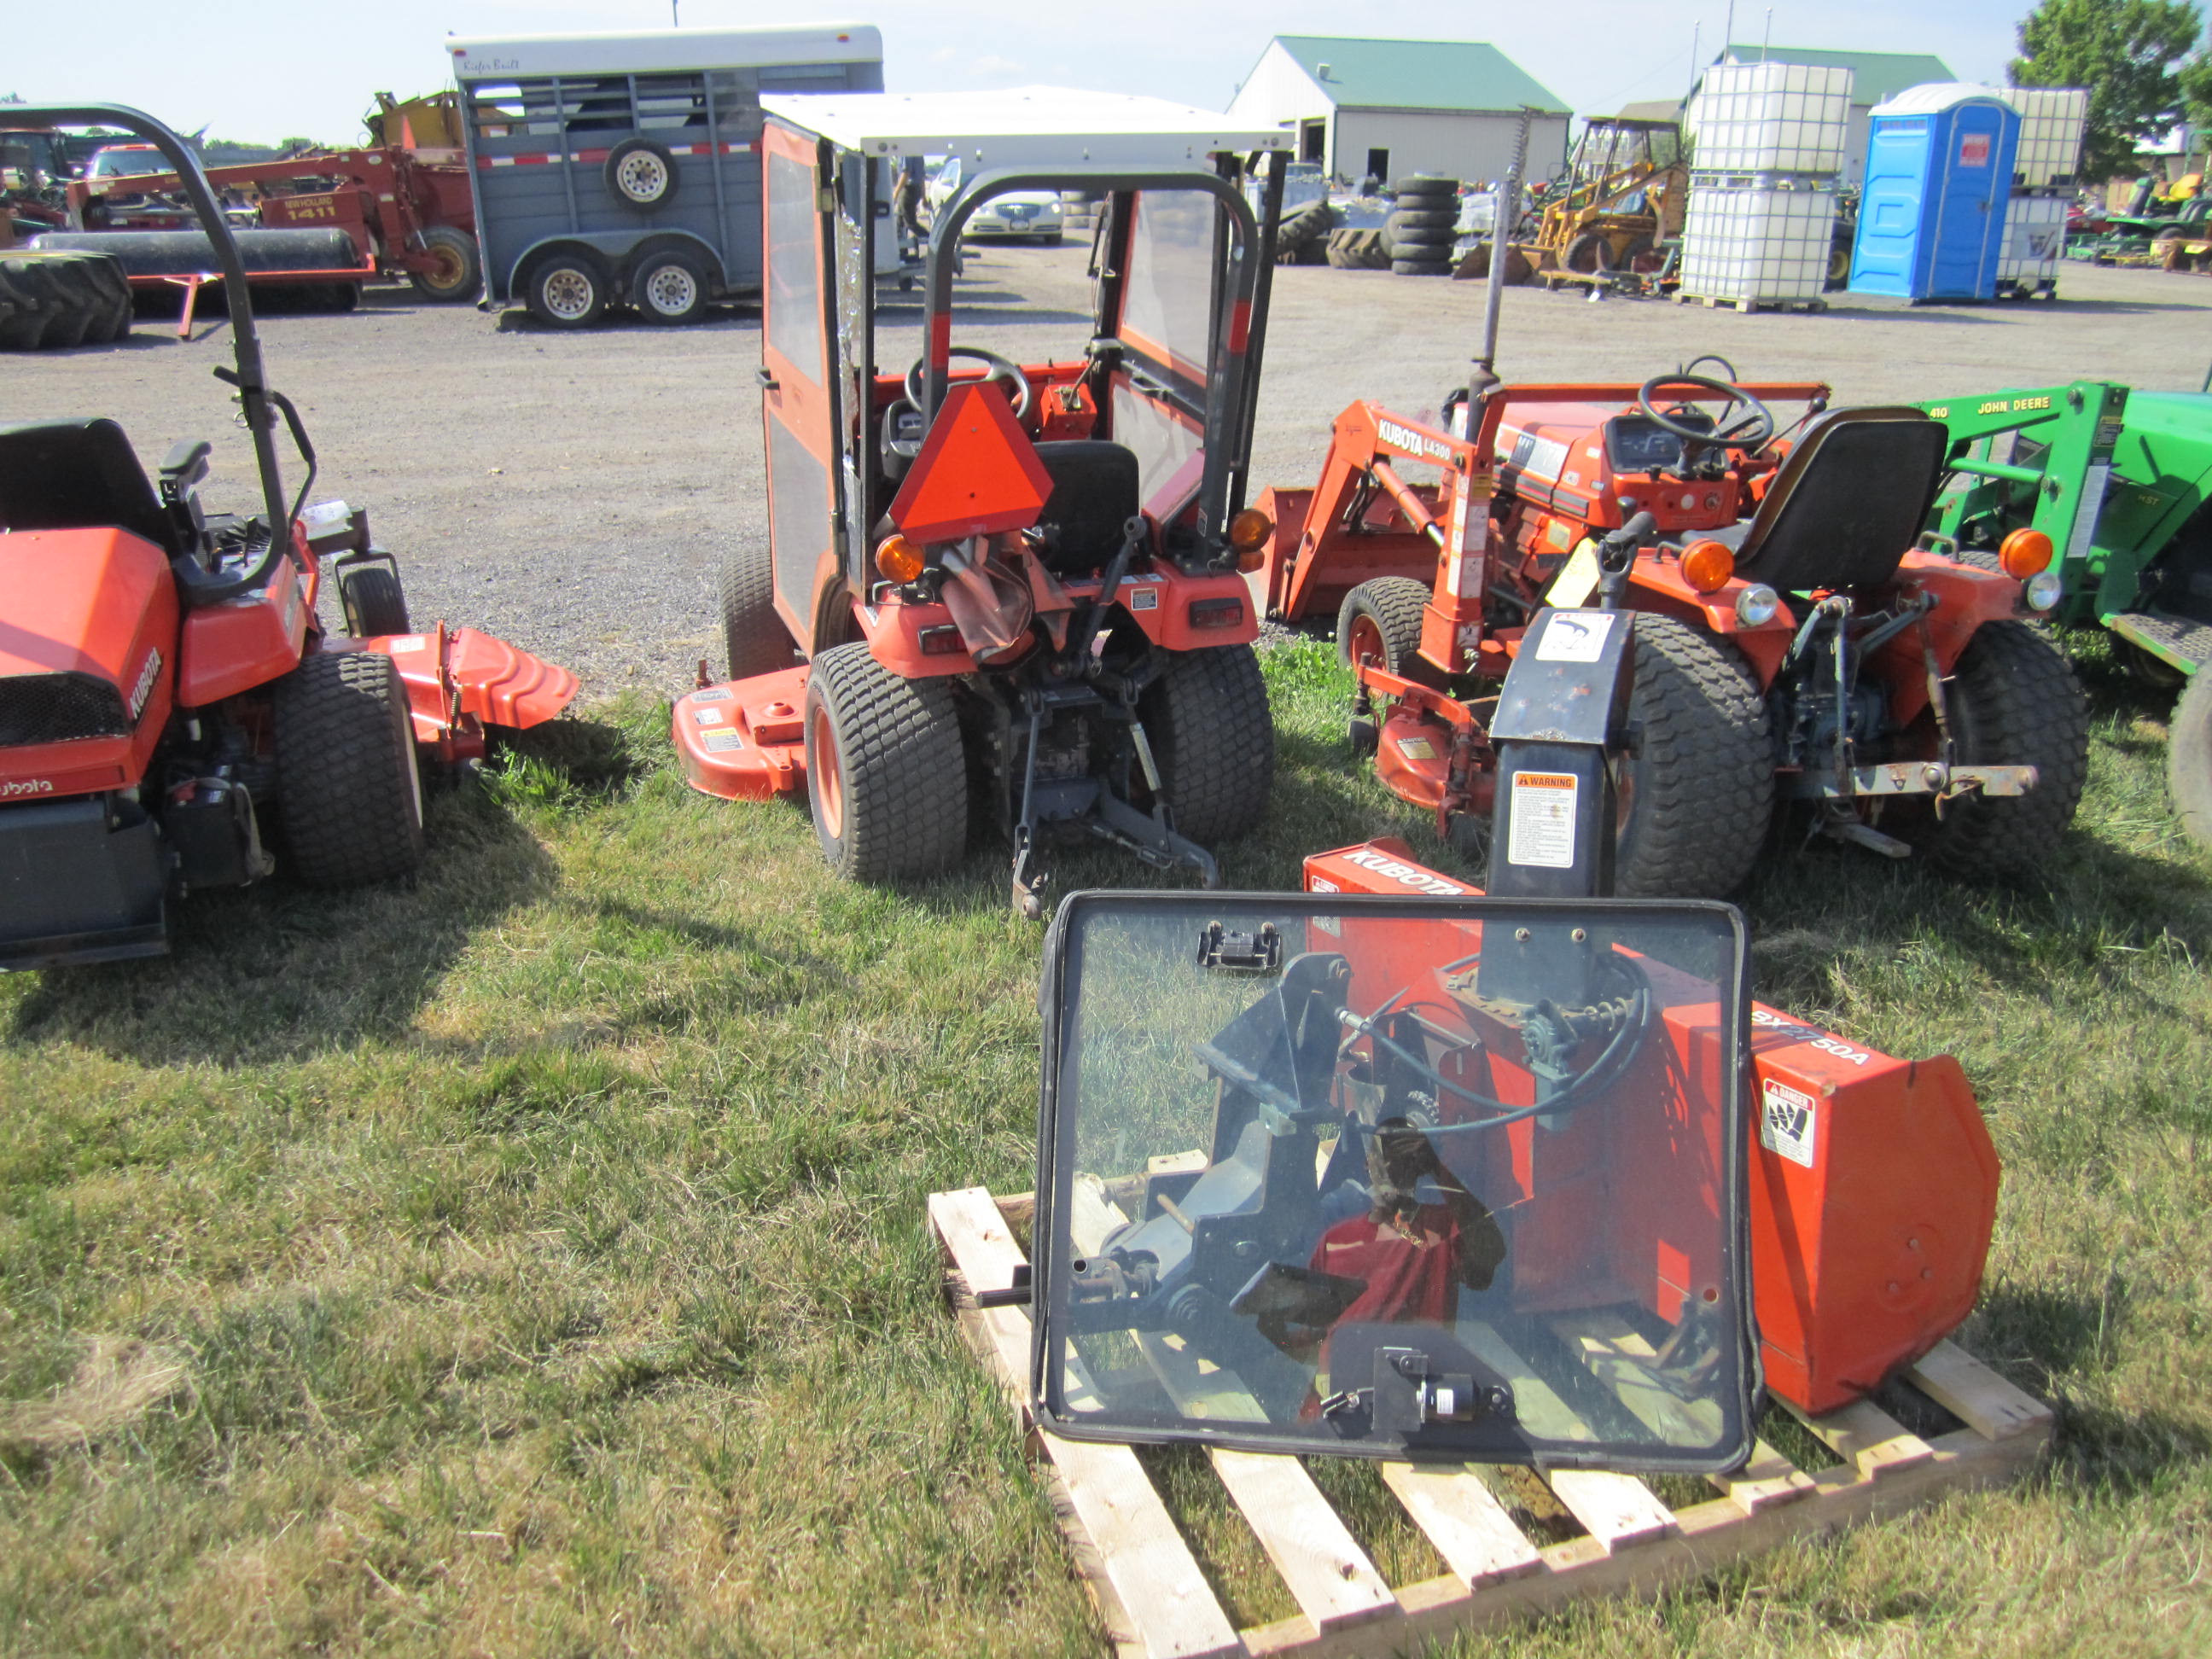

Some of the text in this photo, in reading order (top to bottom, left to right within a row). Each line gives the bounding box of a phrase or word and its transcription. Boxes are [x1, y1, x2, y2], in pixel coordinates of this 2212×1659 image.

[288, 207, 335, 220] 1411
[1930, 397, 2050, 418] 410 JOHN DEERE
[1377, 418, 1451, 461] KUBOTA LA300
[130, 646, 161, 719] KUBOTA
[1530, 777, 1571, 787] WARNING
[1342, 850, 1464, 895] KUBOTA
[1778, 1086, 1808, 1109] DANGER
